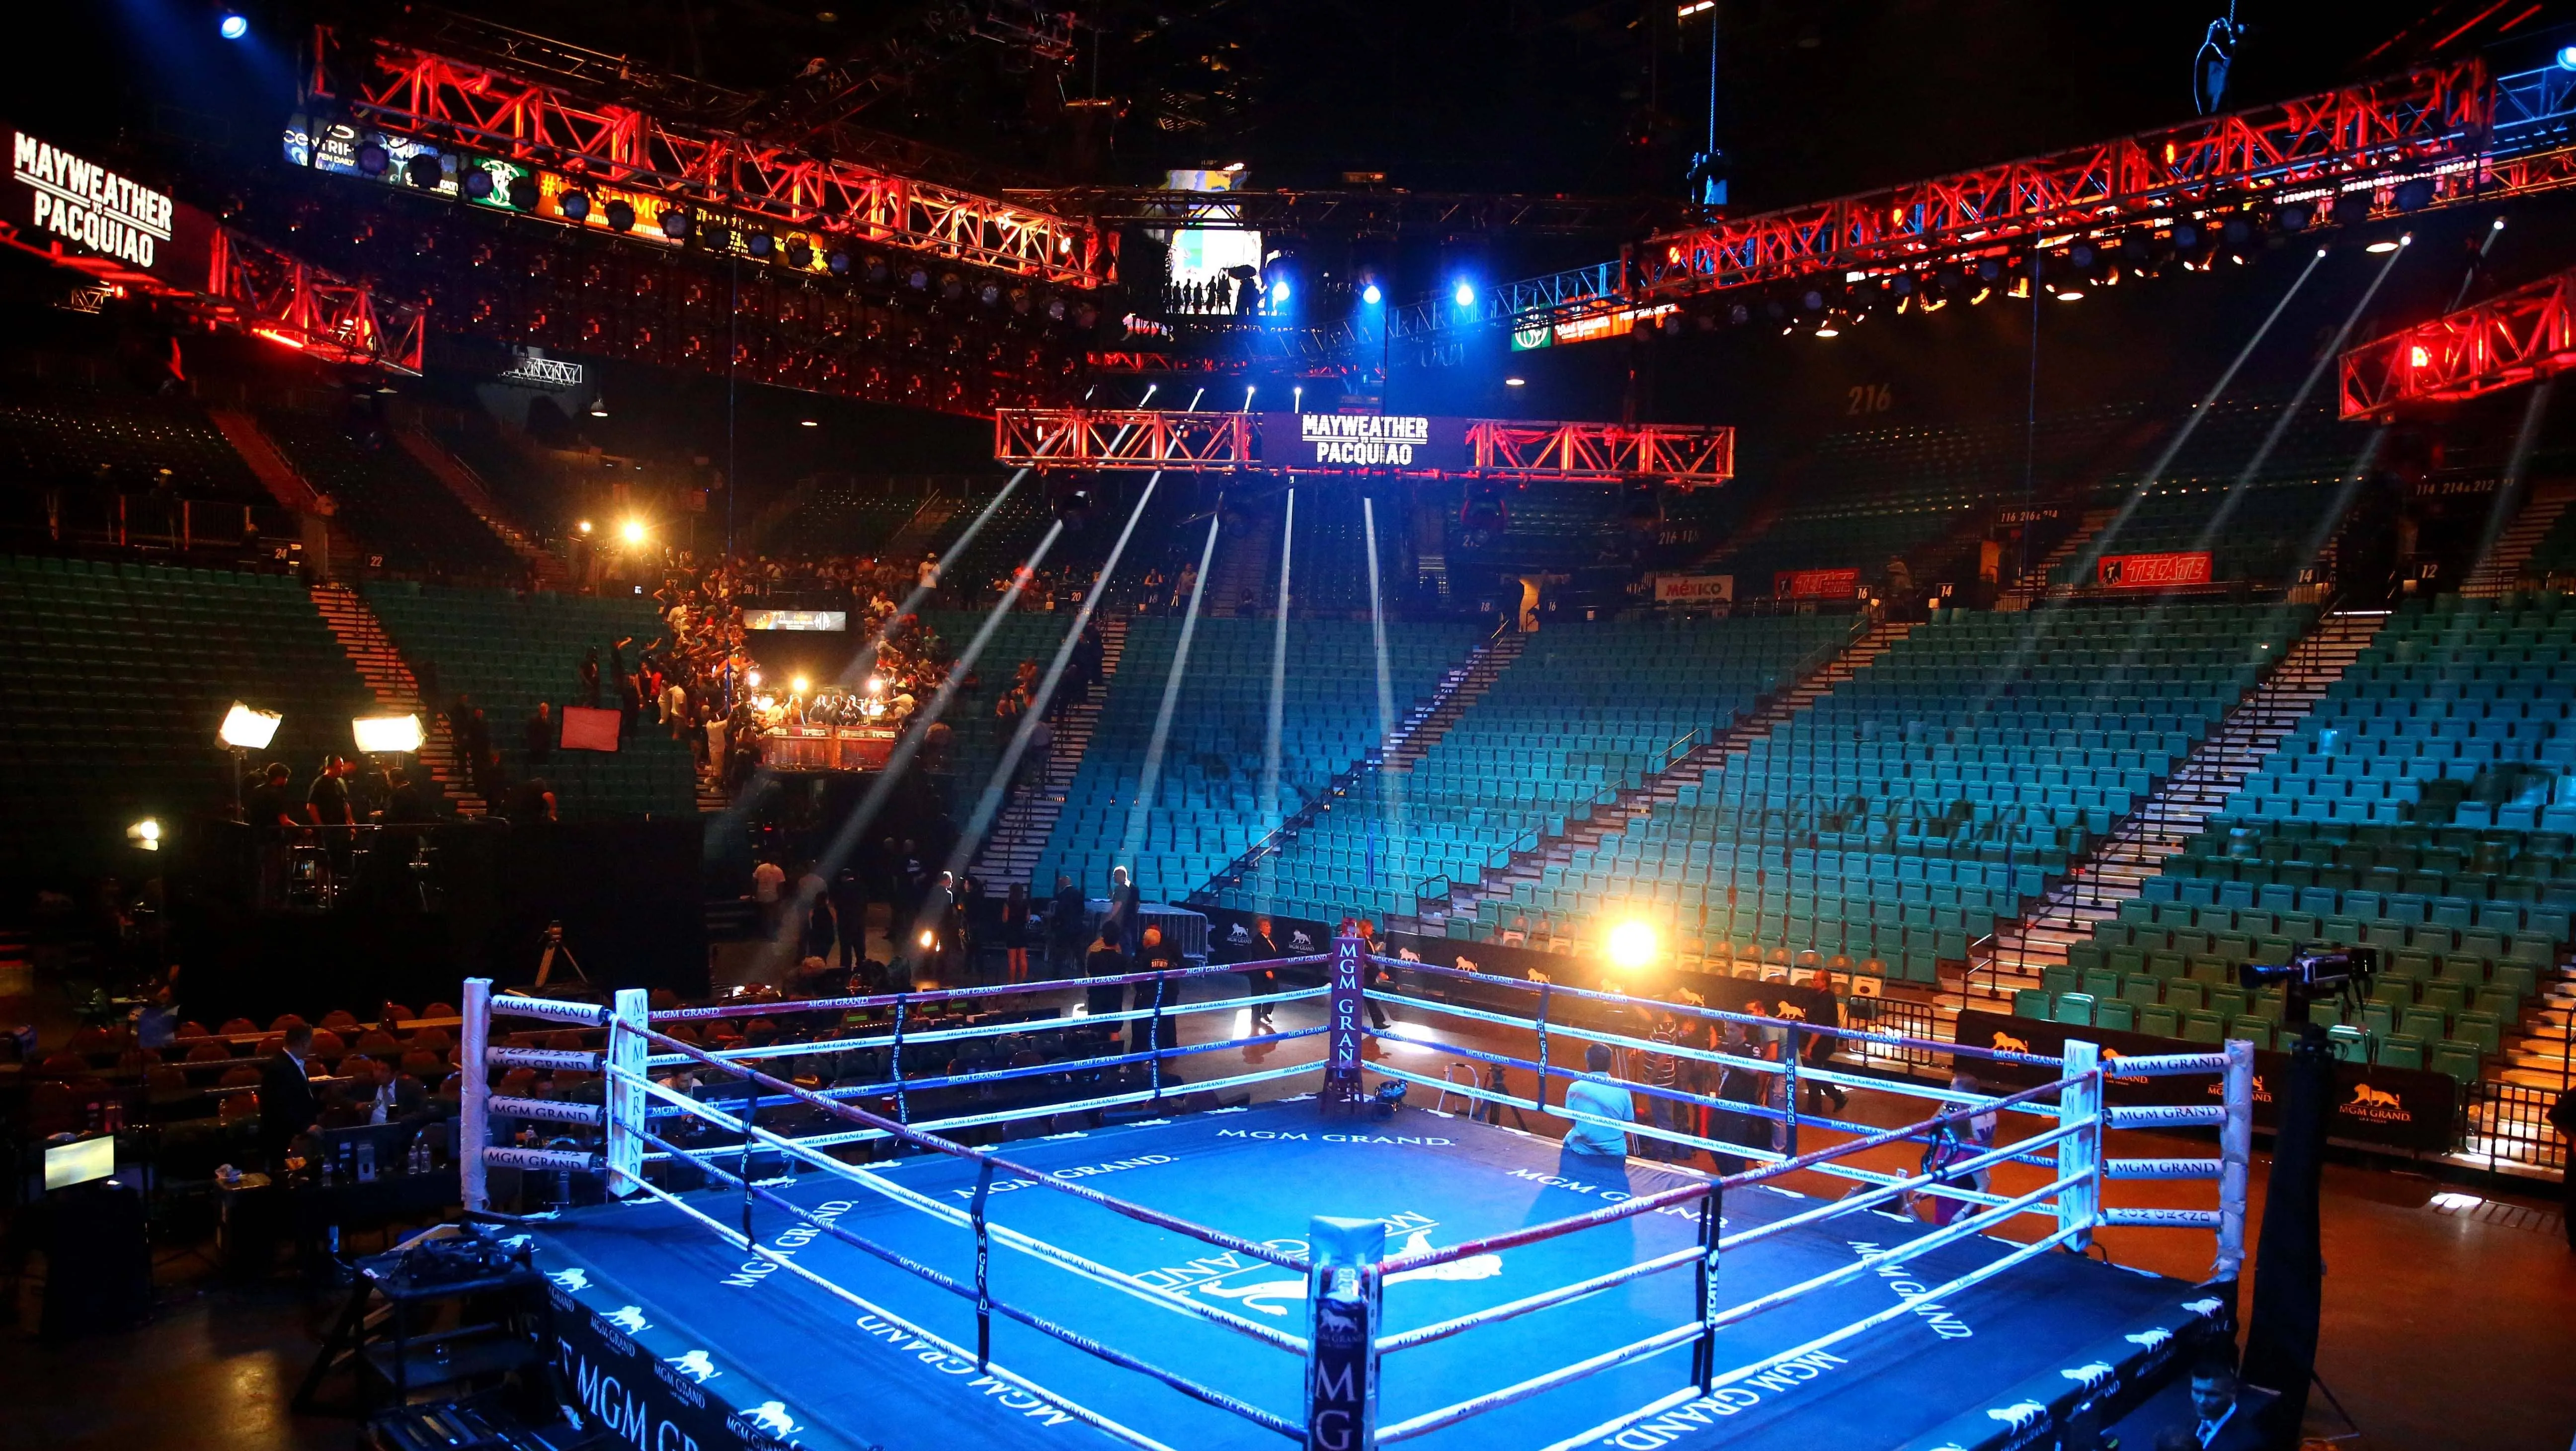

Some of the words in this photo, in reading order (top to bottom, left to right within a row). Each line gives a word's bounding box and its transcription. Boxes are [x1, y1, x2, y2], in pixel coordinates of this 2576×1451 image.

[333, 156, 354, 166] DAILY
[14, 131, 172, 231] MAYWEATHER
[34, 190, 154, 267] PACQUIAO
[1847, 384, 1891, 415] 216
[1302, 414, 1428, 438] MAYWEATHER
[1316, 442, 1413, 465] PACQUIAO
[2473, 479, 2494, 491] 212
[1658, 530, 1677, 545] 216
[274, 548, 287, 560] 24
[370, 556, 383, 566] 22
[2127, 556, 2206, 582] TECATE
[2299, 569, 2314, 582] 14
[2421, 564, 2438, 579] 12
[744, 584, 754, 594] 20
[1857, 587, 1868, 600] 16
[1941, 585, 1952, 597] 14
[1071, 592, 1082, 602] 20
[1481, 602, 1490, 612] 18
[1549, 602, 1556, 612] 16
[1185, 967, 1203, 975] MGM
[1204, 964, 1230, 972] GRAND
[1339, 943, 1358, 990] MGM
[1073, 977, 1095, 985] MGM
[1096, 975, 1123, 983] GRAND
[1469, 972, 1486, 980] MGM
[1487, 974, 1513, 985] GRAND
[497, 1000, 534, 1012] MGM
[539, 1003, 591, 1018] GRAND
[808, 999, 834, 1008] MGM
[835, 997, 869, 1005] GRAND
[652, 1010, 679, 1019] MGM
[682, 1007, 720, 1017] GRAND
[1482, 1012, 1507, 1021] GRAND
[1700, 1009, 1722, 1018] MGM
[1724, 1012, 1756, 1022] GRAND
[1306, 1026, 1328, 1034] GRAND
[1387, 1032, 1409, 1041] GRAND
[1839, 1028, 1862, 1039] MGM
[1863, 1032, 1901, 1043] GRAND
[832, 1040, 867, 1048] GRAND
[1205, 1041, 1230, 1049] GRAND
[1073, 1059, 1095, 1068] MGM
[1096, 1056, 1123, 1065] GRAND
[1465, 1049, 1484, 1058] MGM
[1485, 1052, 1510, 1063] GRAND
[1694, 1051, 1717, 1059] MGM
[1718, 1054, 1750, 1064] GRAND
[1993, 1050, 2021, 1060] MGM
[2024, 1054, 2063, 1065] GRAND
[1302, 1061, 1324, 1070] GRAND
[1366, 1062, 1383, 1071] MGM
[1384, 1067, 1406, 1077] GRAND
[1785, 1057, 1795, 1082] MGM
[2123, 1061, 2163, 1073] MGM
[2167, 1056, 2224, 1069] GRAND
[973, 1071, 1002, 1080] GRAND
[1831, 1073, 1856, 1082] MGM
[1858, 1077, 1894, 1089] GRAND
[1201, 1080, 1226, 1088] GRAND
[835, 1086, 869, 1096] GRAND
[1463, 1087, 1482, 1096] MGM
[1482, 1091, 1508, 1102] GRAND
[1069, 1101, 1092, 1110] MGM
[1093, 1097, 1118, 1105] GRAND
[1694, 1096, 1718, 1105] MGM
[1719, 1100, 1750, 1111] GRAND
[495, 1104, 530, 1116] MGM
[536, 1108, 589, 1121] GRAND
[2119, 1110, 2159, 1121] MGM
[2339, 1105, 2367, 1117] MGM
[1592, 1116, 1621, 1127] GRAND
[1831, 1121, 1855, 1130] MGM
[830, 1132, 864, 1141] GRAND
[1216, 1129, 1310, 1141] MGM
[488, 1151, 524, 1164] MGM
[529, 1156, 581, 1169] GRAND
[1829, 1166, 1853, 1176] MGM
[1855, 1170, 1891, 1182] GRAND
[2115, 1163, 2154, 1173] MGM
[2159, 1162, 2216, 1173] GRAND
[1506, 1168, 1597, 1195] MGM
[552, 1287, 574, 1312] GRAND
[1706, 1273, 1718, 1328] TECATE
[590, 1315, 609, 1338] MGM
[609, 1326, 636, 1357] GRAND
[1744, 1350, 1848, 1392] MGM
[653, 1362, 675, 1387] MGM
[676, 1377, 706, 1409] GRAND
[576, 1354, 646, 1451] MGM
[725, 1415, 749, 1443] MGM
